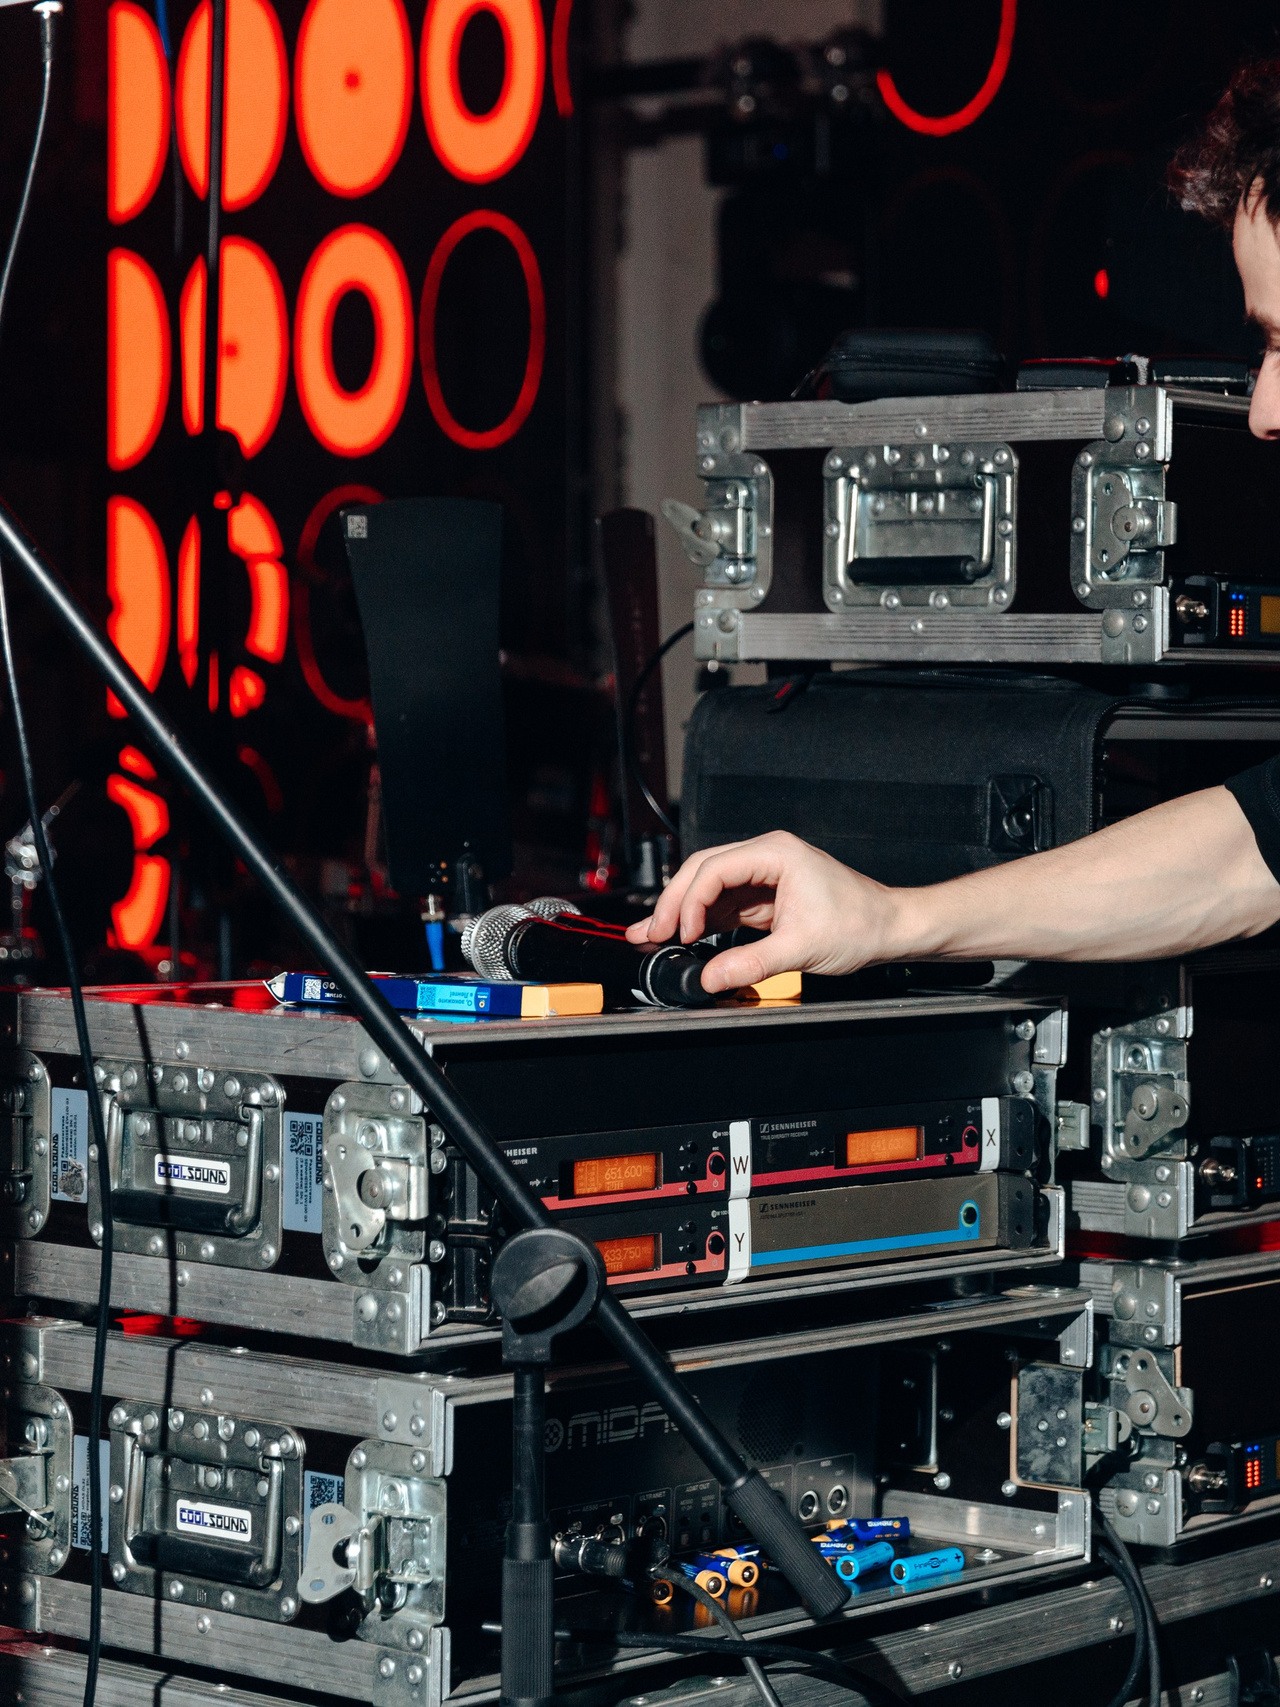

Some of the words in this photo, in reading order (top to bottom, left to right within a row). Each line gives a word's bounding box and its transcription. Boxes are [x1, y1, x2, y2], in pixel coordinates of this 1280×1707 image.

[770, 1120, 817, 1131] SENNHEISER
[986, 1129, 996, 1147] X
[604, 1165, 642, 1181] 651.600
[733, 1155, 748, 1175] W
[770, 1200, 816, 1211] SENNHEISER
[735, 1233, 745, 1252] Y
[604, 1246, 641, 1262] 633.750
